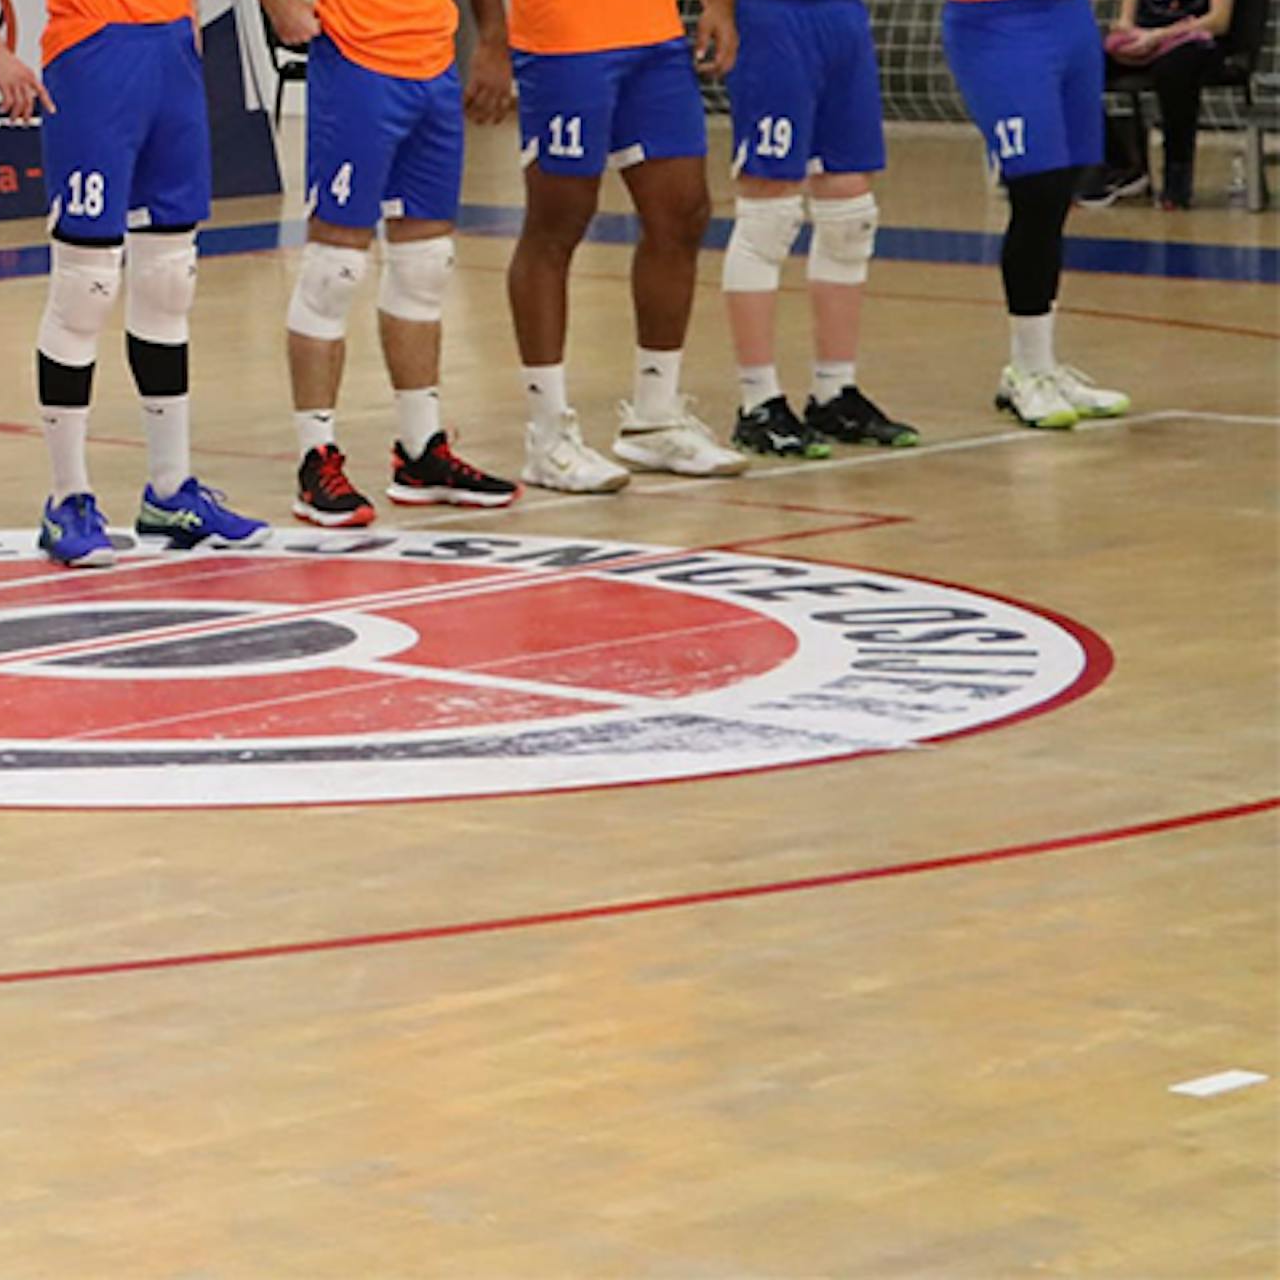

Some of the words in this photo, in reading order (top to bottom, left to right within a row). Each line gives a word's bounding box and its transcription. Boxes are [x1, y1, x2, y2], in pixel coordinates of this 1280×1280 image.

[546, 113, 587, 159] 11
[753, 114, 795, 160] 19
[992, 115, 1027, 160] 17
[65, 169, 107, 218] 18
[328, 160, 354, 207] 4
